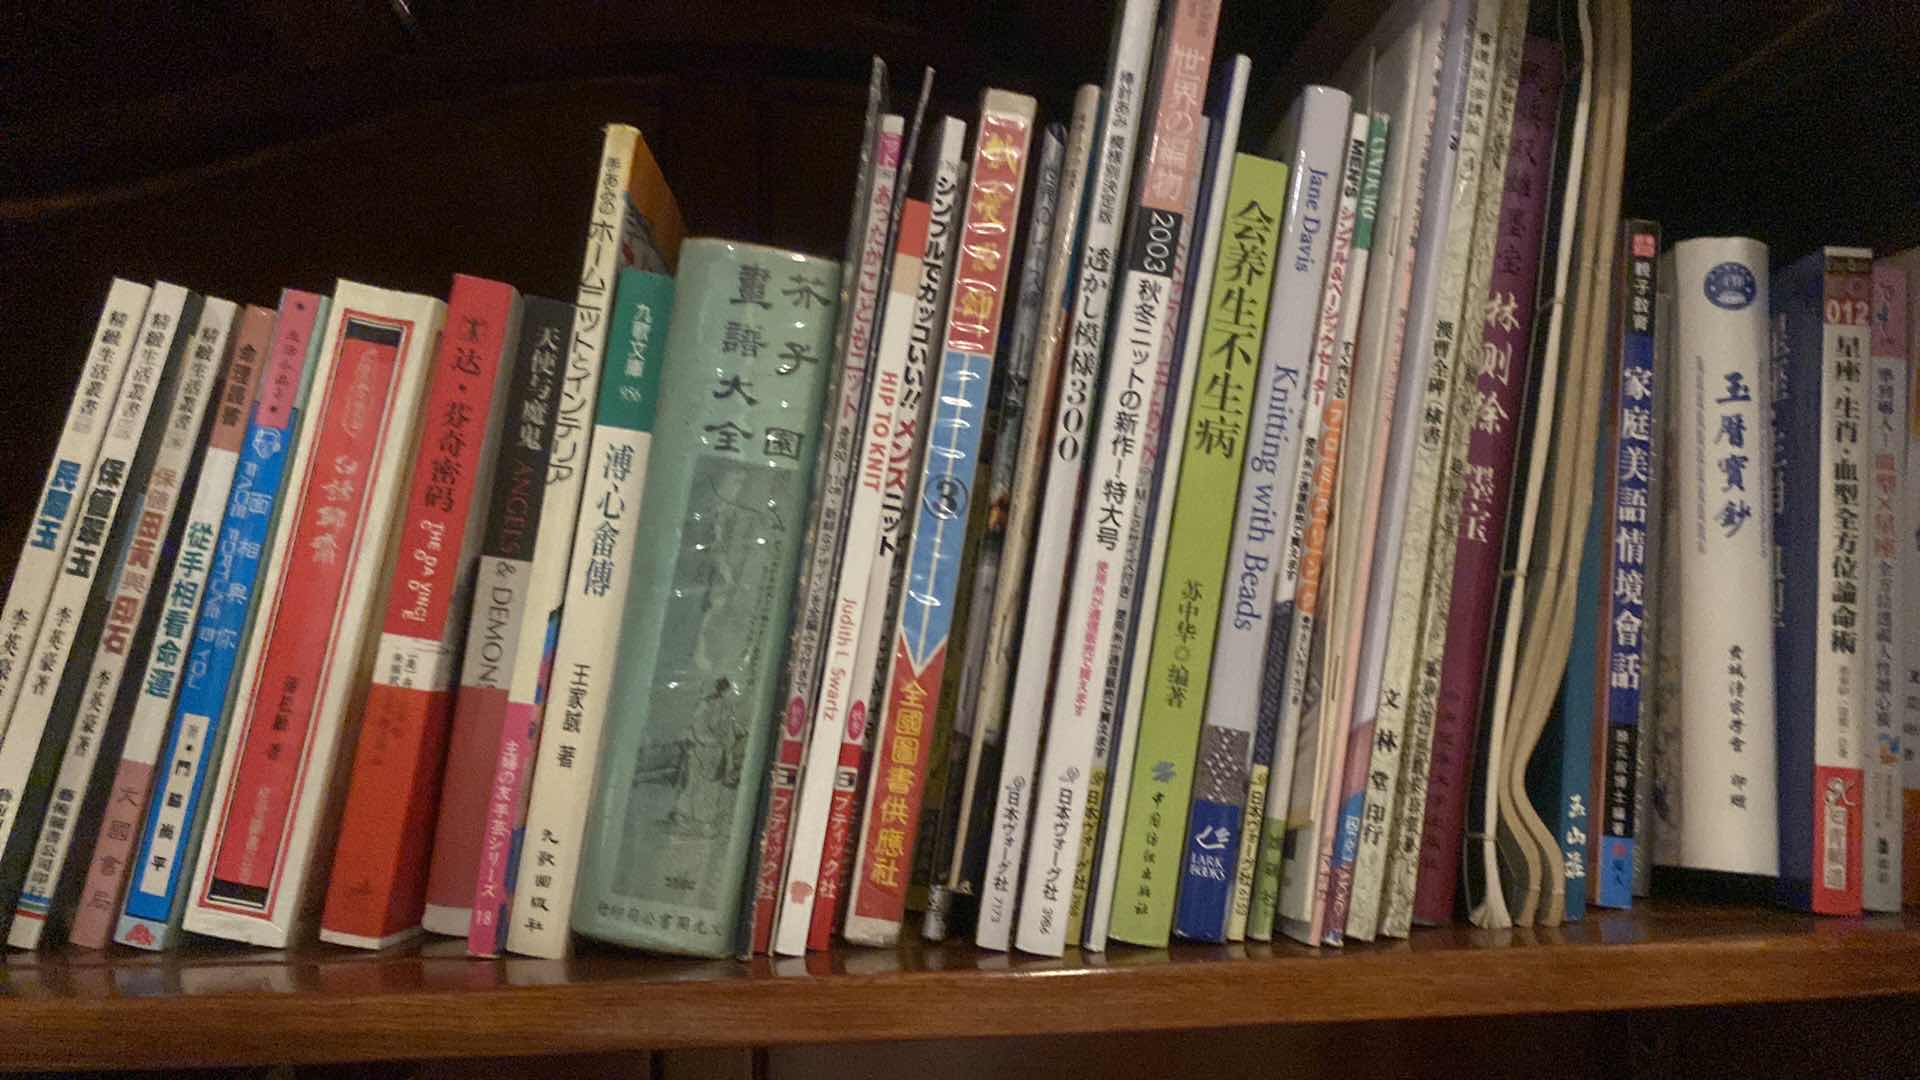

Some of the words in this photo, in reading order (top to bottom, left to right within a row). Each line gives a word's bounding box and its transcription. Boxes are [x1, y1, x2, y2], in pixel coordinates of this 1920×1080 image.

[1306, 167, 1328, 209] Jane
[1145, 211, 1174, 273] 2003
[1296, 219, 1321, 272] Davis
[1196, 200, 1273, 459] 会养生不生病
[1824, 302, 1869, 324] 012
[879, 371, 898, 407] HIP
[872, 409, 894, 441] TO
[1250, 364, 1299, 477] Knitting
[863, 443, 888, 492] KNIT
[504, 462, 534, 555] ANGELS
[1248, 483, 1276, 541] with
[1611, 365, 1653, 689] 家庭美語情境會話
[428, 520, 444, 551] THE
[422, 557, 437, 577] DA
[496, 562, 516, 577] &
[1234, 552, 1270, 630] Beads
[840, 598, 857, 640] Judith
[824, 669, 846, 721] Swartz
